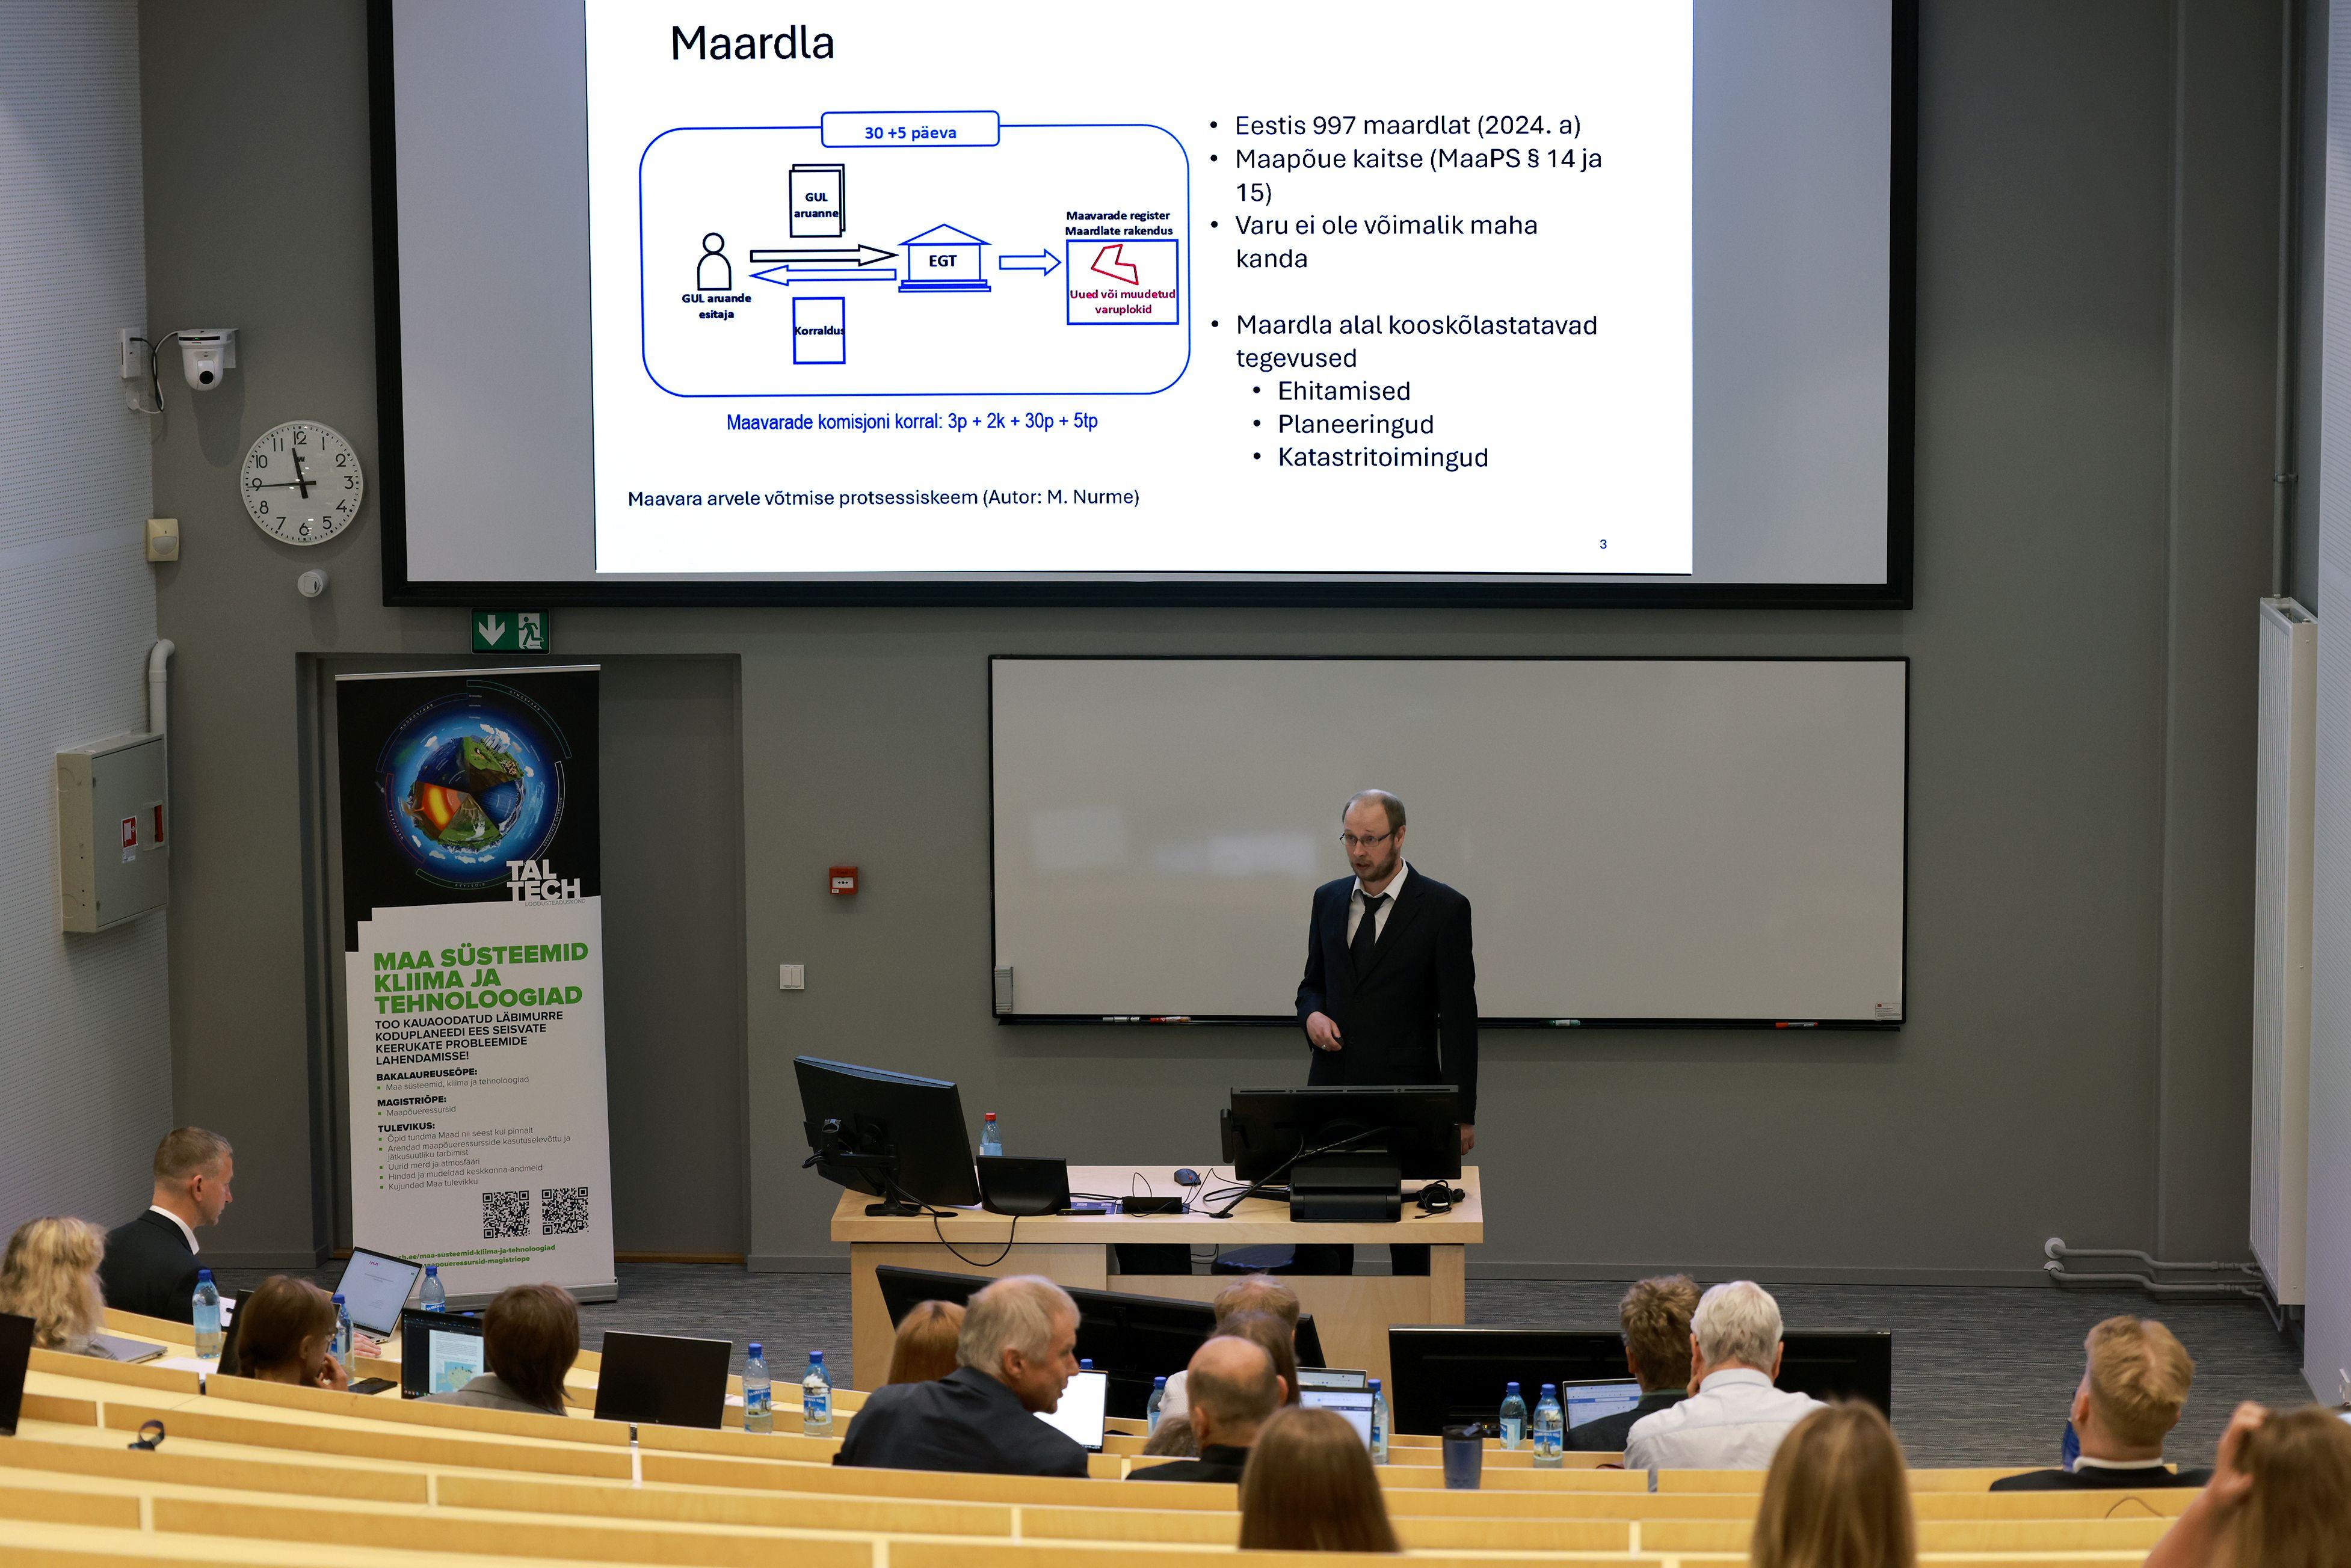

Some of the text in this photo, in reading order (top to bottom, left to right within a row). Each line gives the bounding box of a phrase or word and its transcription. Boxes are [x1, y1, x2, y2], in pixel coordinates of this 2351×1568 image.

[673, 24, 834, 60] Maardla
[864, 126, 957, 143] 30 +5 päeva
[1236, 115, 1580, 140] Eestis 997 maardlat (2024. a)
[1236, 147, 1602, 173] Maapõue kaitse (MaaPS § 14 ja
[805, 192, 828, 202] GUL
[1237, 182, 1272, 206] 15)
[793, 209, 839, 218] aruanne
[1067, 210, 1171, 222] Maavarade register
[1065, 225, 1174, 236] Maardlate rakendus
[1235, 214, 1537, 235] Varu ei ole võimalik maha
[929, 254, 958, 267] EGT
[1237, 248, 1307, 268] kanda
[682, 292, 752, 303] GUL aruande
[1070, 289, 1176, 300] Uued või muudetud
[698, 309, 735, 321] esitaja
[1095, 304, 1152, 316] varuplokid
[794, 325, 845, 335] Korraldus
[1237, 315, 1597, 335] Maardla alal kooskõlastatavad
[1236, 348, 1357, 372] tegevused
[1279, 380, 1410, 401] Ehitamised
[727, 412, 1098, 434] Maavarade komisjoni korral: 3p + 2k + 30p + 5tp
[1279, 414, 1434, 439] Planeeringud
[273, 437, 283, 451] 11
[294, 431, 307, 444] 12
[256, 455, 268, 469] 10
[335, 453, 347, 467] 2
[1280, 446, 1488, 472] Katastritoimingud
[251, 478, 262, 491] 9
[344, 475, 354, 490] 3
[336, 499, 347, 512] 4
[629, 489, 1139, 509] Maavara arvele võtmise protsessiskeem (Autor: M. Nurme)
[259, 500, 269, 514] 8
[276, 517, 286, 530] 7
[299, 523, 310, 536] 6
[322, 516, 332, 530] 5
[1600, 539, 1607, 549] 3
[506, 859, 557, 881] TAL
[507, 878, 581, 902] TECH
[525, 898, 587, 907] LOODUSTEADUSKOND
[374, 942, 588, 971] MAA SÜSTEEMID
[374, 968, 502, 993] KLIIMA JA
[374, 986, 583, 1015] TEHNOLOOGIAD
[374, 1010, 563, 1030] TOO KAUAOODATUD LÄBIMURRE
[375, 1023, 546, 1042] KODUPLANEEDI EES SEISVATE
[375, 1036, 528, 1054] KEERUKATE PROBLEEMIDE
[376, 1051, 469, 1065] LAHENDAMISSE!
[376, 1068, 478, 1081] BAKALAUREUSEÕPE:
[446, 1079, 469, 1088] kliima
[469, 1078, 477, 1088] ja
[479, 1075, 529, 1085] tehnoloogiad
[377, 1094, 447, 1107] MAGISTRIÕPE:
[386, 1106, 457, 1117] Maapõueressursid
[377, 1122, 436, 1133] TULEVIKUS:
[387, 1133, 406, 1143] Õpid
[408, 1133, 436, 1141] tundma
[438, 1131, 460, 1139] Maad
[508, 1127, 534, 1136] pinnalt
[387, 1135, 571, 1152] Arendad maapõueressursside kasutuselevõttu ja
[436, 1148, 469, 1160] tarbimist
[388, 1160, 408, 1170] Uurid
[410, 1161, 430, 1169] merd
[432, 1160, 439, 1169] ja
[388, 1164, 543, 1181] Hindad ja mudeldad keskkonna-andmeid
[389, 1178, 478, 1191] Kujundad Maa tulevikku
